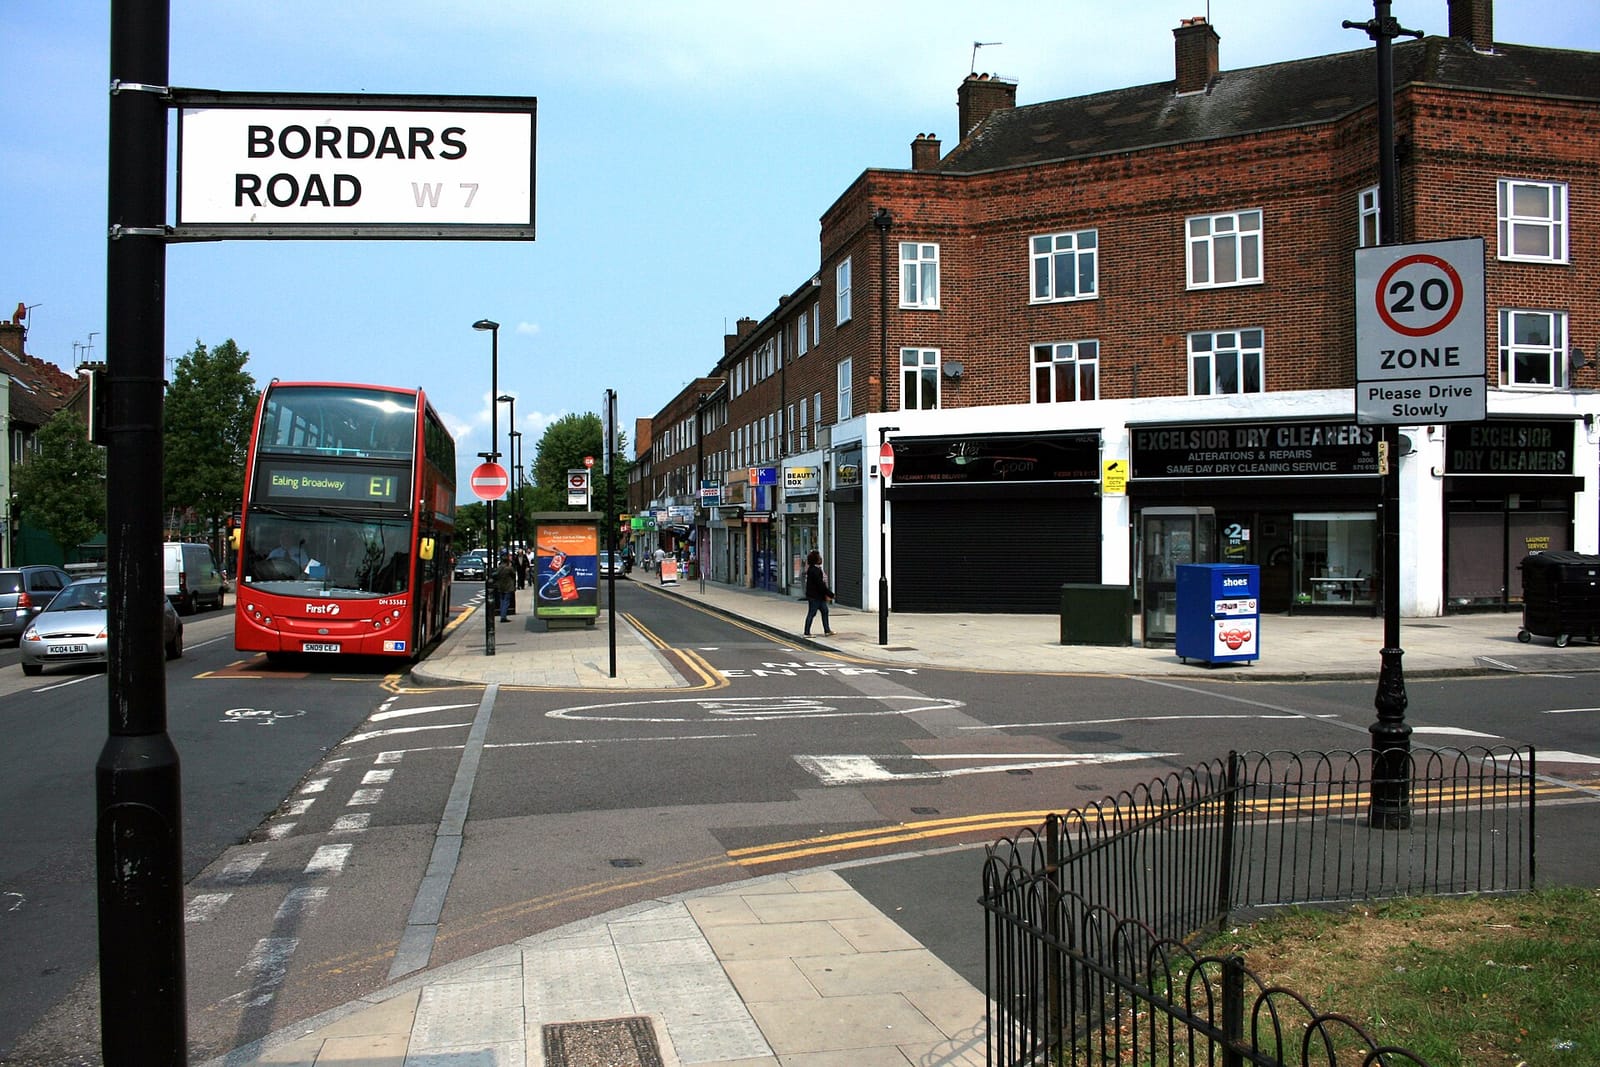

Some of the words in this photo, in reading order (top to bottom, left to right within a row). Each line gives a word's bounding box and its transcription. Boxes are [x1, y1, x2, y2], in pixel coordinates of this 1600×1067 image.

[248, 125, 468, 160] BORDARS
[235, 173, 362, 207] ROAD
[411, 182, 443, 208] W
[460, 183, 479, 208] 7
[1389, 278, 1449, 314] 20
[1380, 346, 1460, 370] ZONE
[1369, 387, 1421, 401] Please
[1429, 384, 1473, 399] Drive
[1392, 402, 1448, 418] Slowly
[1137, 430, 1230, 451] EXCELSIOR
[1235, 428, 1271, 448] DRY
[1277, 425, 1374, 447] CLEANERS
[1470, 426, 1551, 447] EXCELSIOR
[1188, 451, 1254, 462] ALTERATIONS
[1258, 451, 1266, 460] &
[1269, 450, 1312, 460] REPAIRS
[1454, 451, 1482, 470] DRY
[1490, 450, 1565, 470] CLEANERS
[759, 469, 766, 477] K
[993, 460, 1034, 479] Spoon
[1167, 465, 1194, 474] SAME
[1195, 465, 1215, 474] DAY
[1216, 464, 1236, 474] DRY
[1238, 463, 1291, 473] CLEANING
[1292, 462, 1337, 472] SERVICE
[272, 475, 299, 490] Ealing
[301, 476, 345, 491] Broadway
[369, 476, 391, 496] E1
[1228, 523, 1242, 538] 2
[1223, 577, 1248, 587] shoes
[306, 603, 326, 614] First
[305, 644, 323, 652] SN09
[717, 668, 919, 678] ENTRY
